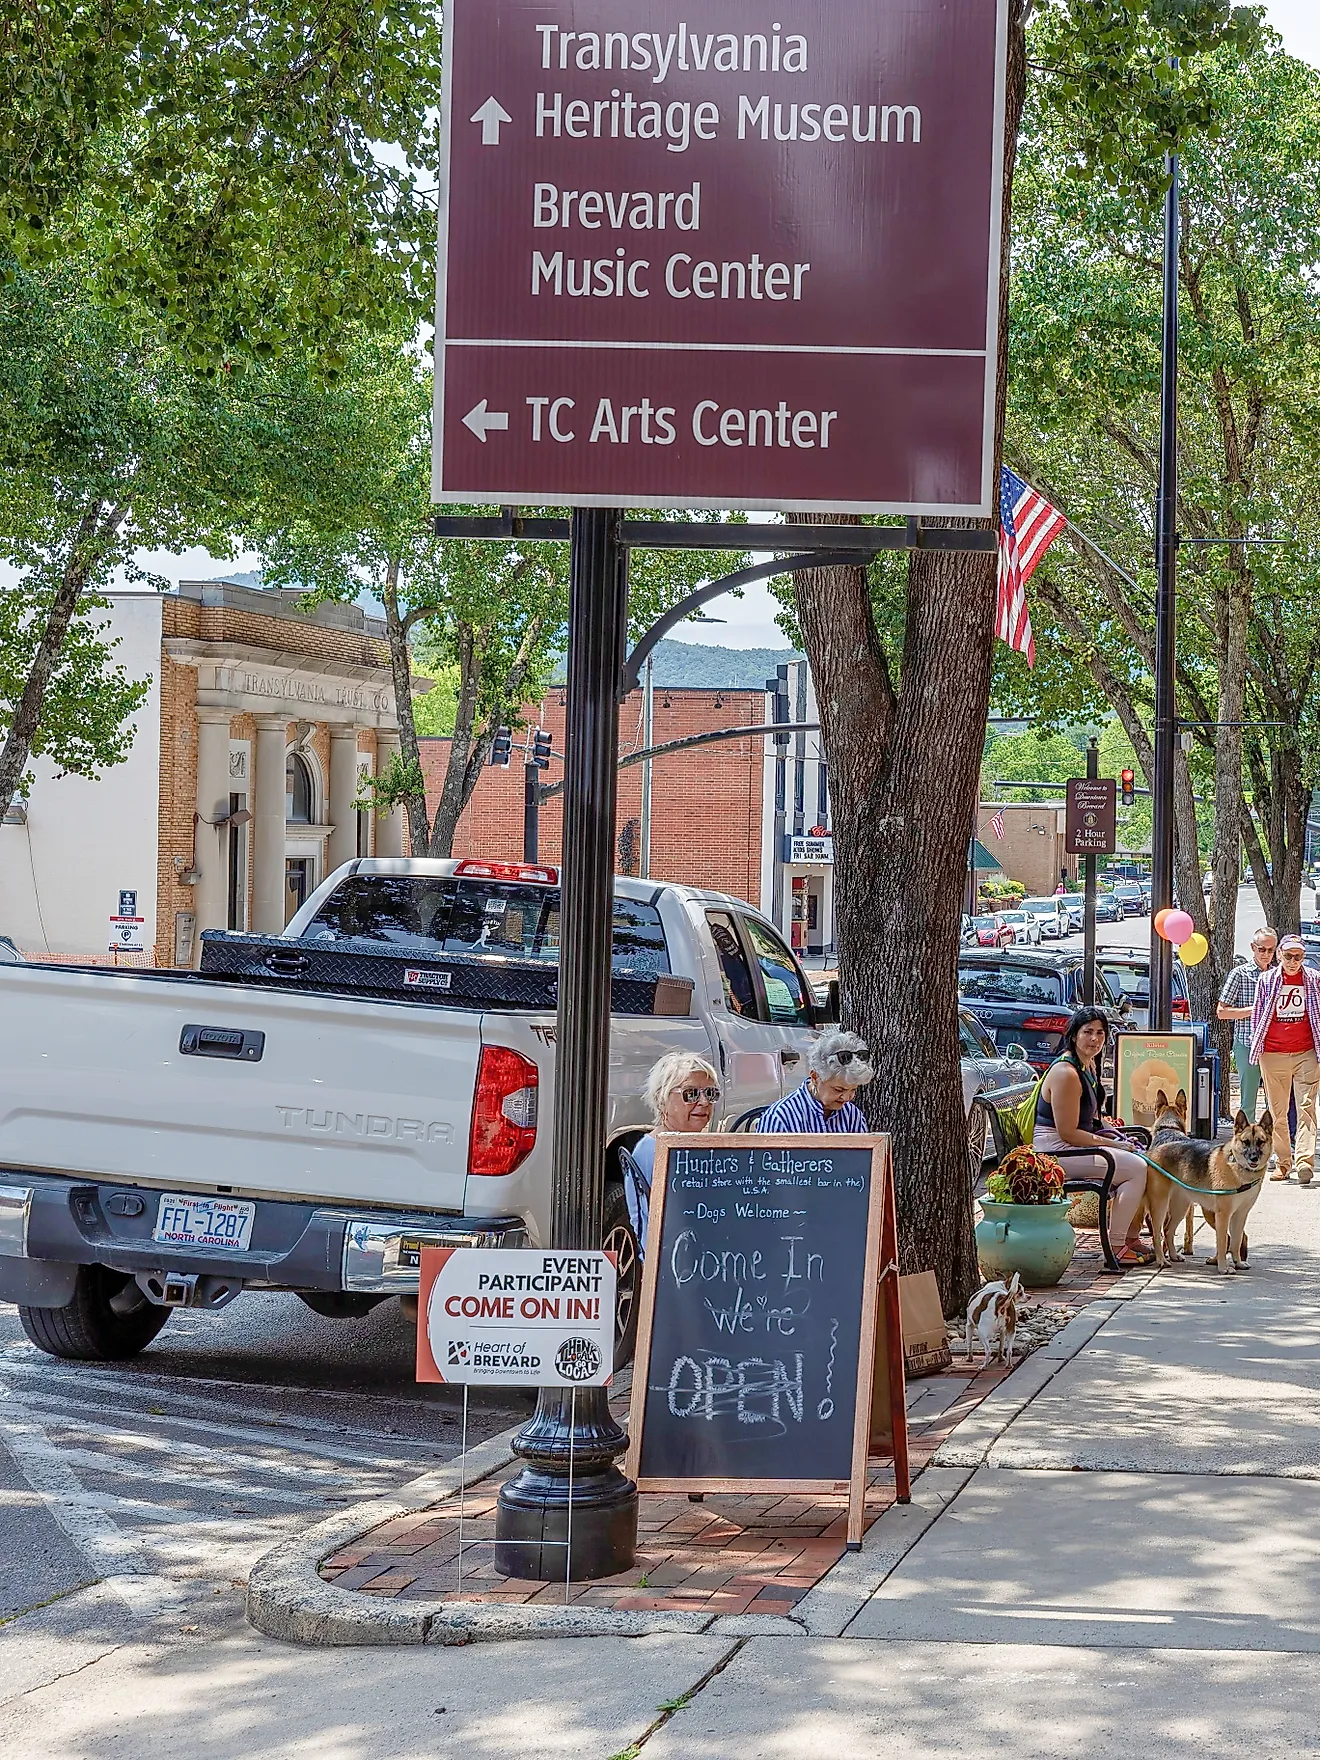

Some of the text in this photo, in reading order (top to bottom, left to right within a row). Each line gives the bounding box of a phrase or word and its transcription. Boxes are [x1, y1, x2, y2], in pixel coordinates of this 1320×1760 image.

[536, 22, 809, 83] Transylvania
[534, 88, 923, 152] Heritage Museum
[532, 182, 701, 231] Brevard
[531, 248, 811, 301] Music Center
[526, 396, 838, 448] TC Arts Center
[244, 672, 390, 710] TRANSYLVANIA TRUST CO
[1075, 781, 1101, 791] Welcome
[1075, 792, 1108, 801] Downtown
[1077, 801, 1106, 809] Brevard
[1076, 829, 1106, 838] 2 Hour
[1075, 838, 1107, 848] Parking
[419, 972, 449, 980] TRACTOR
[203, 1032, 240, 1044] TOYOTA
[276, 1105, 455, 1144] TUNDRA
[761, 1150, 833, 1174] Gatherers
[711, 1178, 733, 1187] store
[735, 1177, 754, 1186] with
[757, 1177, 772, 1186] the
[774, 1177, 812, 1186] smallest
[817, 1178, 831, 1187] bar
[832, 1179, 843, 1187] in
[161, 1207, 248, 1238] FFL-1287
[164, 1232, 240, 1247] NORTH CAROLINA
[542, 1258, 603, 1275] EVENT
[671, 1230, 824, 1288] Come In
[478, 1274, 603, 1292] PARTICIPANT
[444, 1296, 600, 1320] COME ON IN!
[474, 1341, 527, 1354] Heart of
[473, 1355, 541, 1368] BREVARD
[559, 1362, 597, 1379] LOCAL
